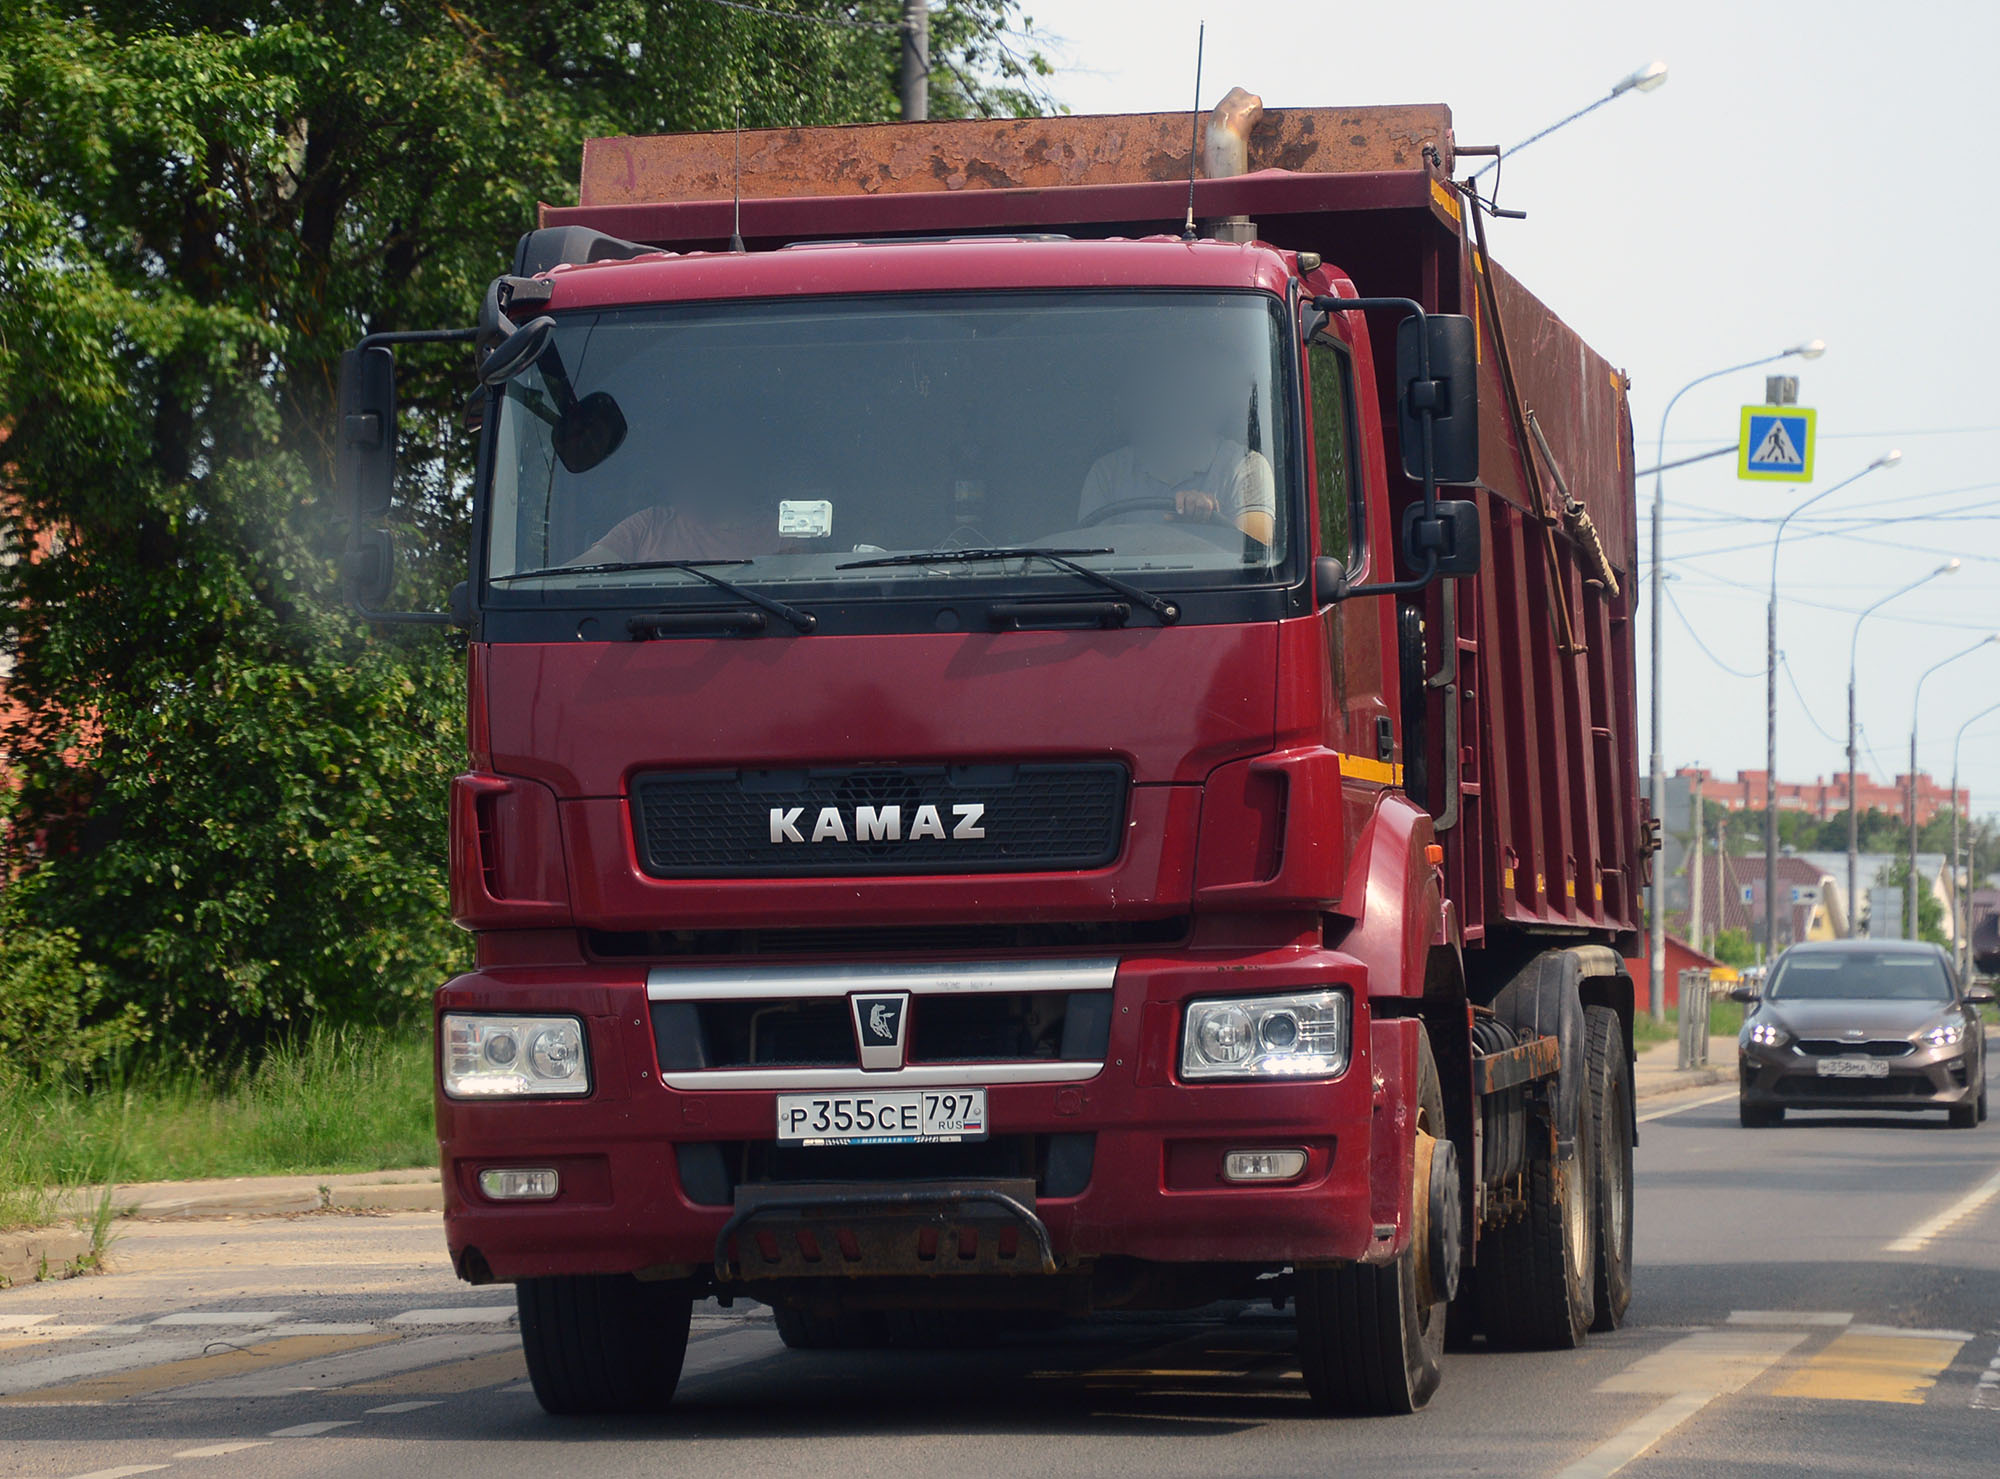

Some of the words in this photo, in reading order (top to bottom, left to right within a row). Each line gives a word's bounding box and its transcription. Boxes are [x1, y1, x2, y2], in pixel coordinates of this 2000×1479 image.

[770, 804, 985, 843] KAMAZ
[925, 1095, 974, 1120] 797
[938, 1120, 963, 1130] RUS
